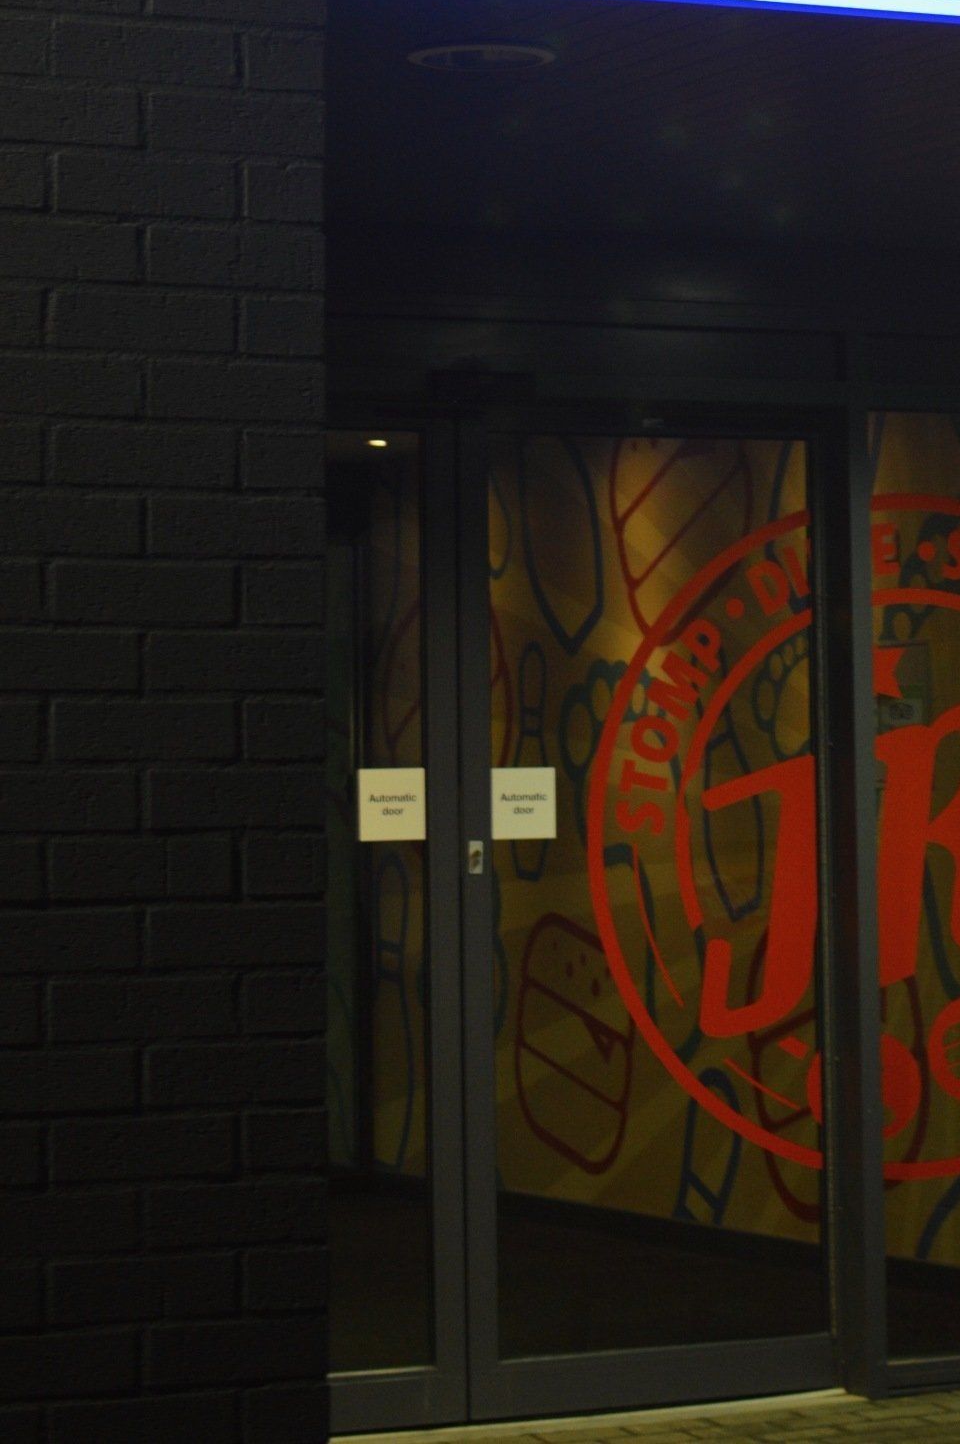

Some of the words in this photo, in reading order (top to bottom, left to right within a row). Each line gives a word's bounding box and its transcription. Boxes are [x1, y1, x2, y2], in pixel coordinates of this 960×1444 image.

[615, 617, 722, 835] STOMP
[745, 522, 901, 617] DIE
[368, 792, 417, 804] Automatic
[500, 791, 548, 803] Automatic
[381, 806, 404, 816] door
[513, 805, 534, 815] door
